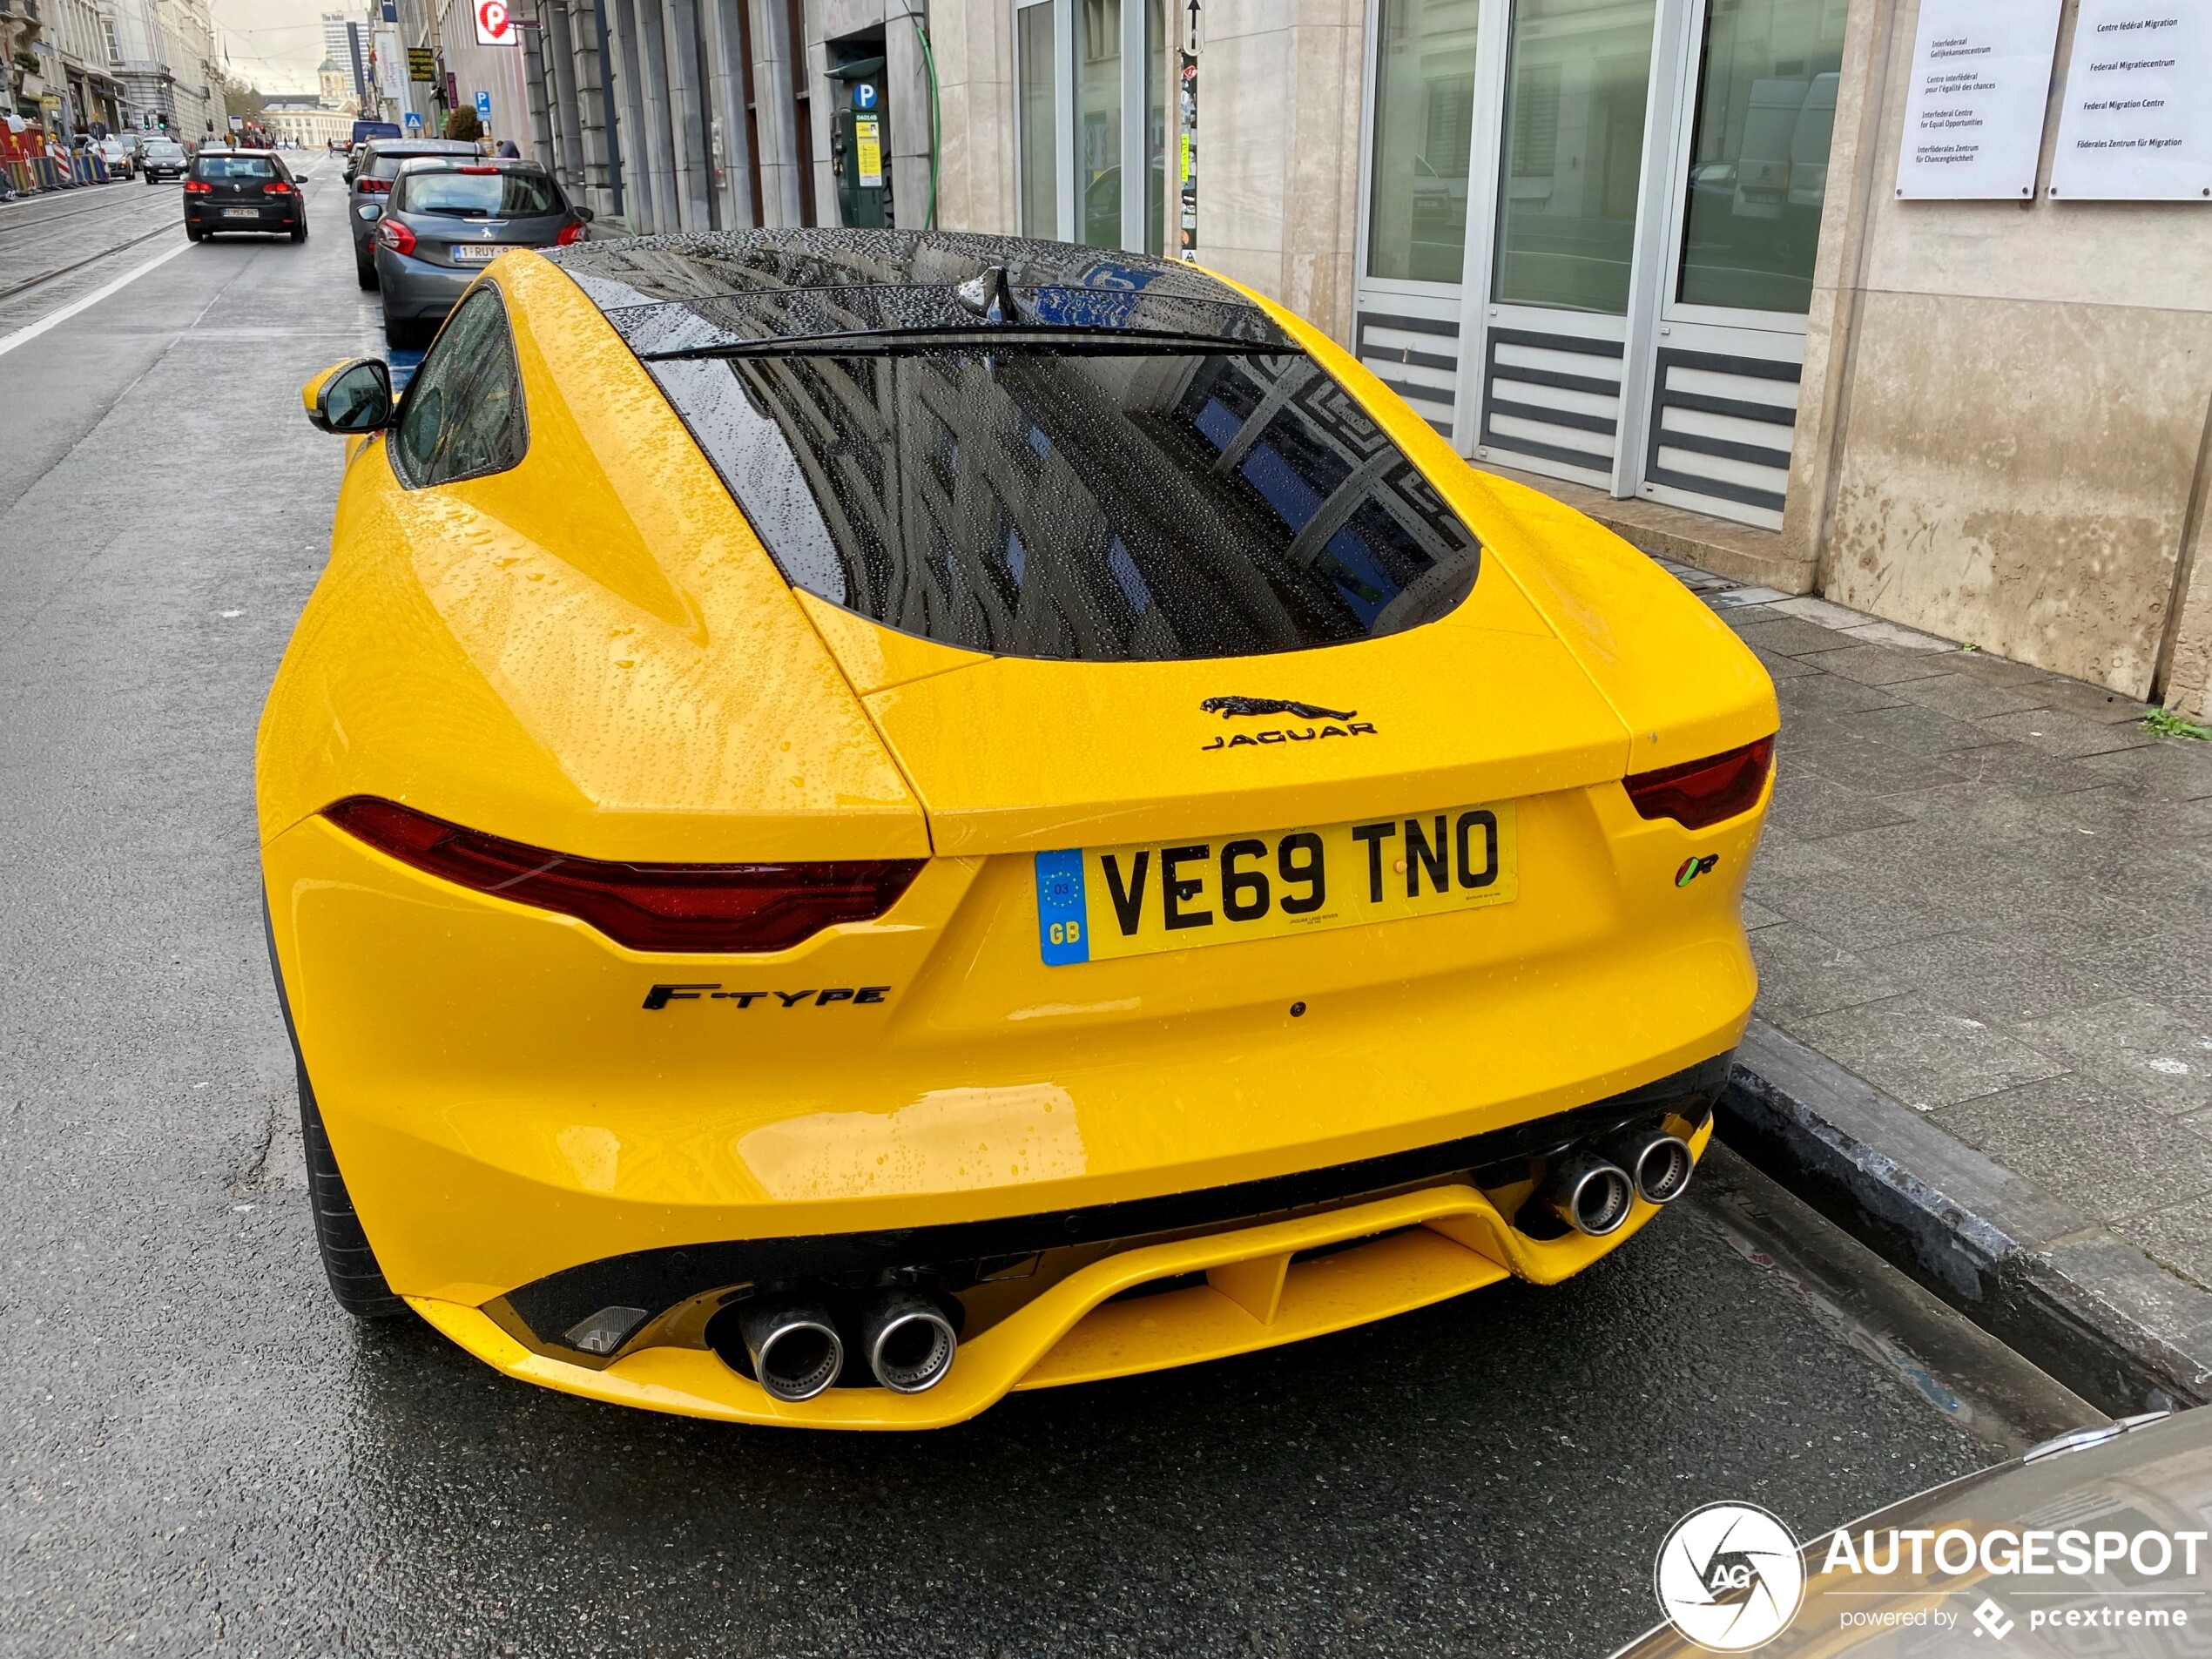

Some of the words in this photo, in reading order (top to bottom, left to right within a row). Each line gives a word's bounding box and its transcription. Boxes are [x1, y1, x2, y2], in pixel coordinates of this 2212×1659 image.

[2097, 23, 2118, 32] Centre
[2120, 20, 2143, 30] fédéral
[2145, 18, 2178, 30] Migration
[1932, 37, 1967, 48] Interfederaal
[1930, 46, 1991, 58] Gelijkekansencentrum
[2090, 61, 2118, 71] Federaal
[2119, 58, 2175, 71] Migratiecentrum
[1946, 72, 1978, 83] interfédéral
[860, 84, 873, 106] P
[1925, 86, 1938, 95] pour
[1939, 83, 1961, 93] l'égalité
[477, 91, 486, 105] P
[2083, 101, 2107, 110] Federal
[2108, 99, 2141, 111] Migration
[2142, 98, 2165, 108] Centre
[1922, 110, 1953, 118] Interfederal
[1929, 120, 1945, 129] Equal
[1945, 118, 1983, 129] Opportunities
[1917, 145, 1955, 153] Interföderales
[2077, 139, 2107, 148] Föderales
[2108, 138, 2136, 148] Zentrum
[2137, 138, 2148, 147] für
[2148, 138, 2182, 148] Migration
[1925, 155, 1974, 164] Chancengleichheit
[1201, 723, 1379, 751] JAGUAR
[1101, 832, 1325, 937] VE69
[1352, 809, 1498, 904] TNO
[1054, 883, 1069, 895] 03
[1049, 921, 1080, 945] GB
[642, 983, 892, 1010] F-TYPE
